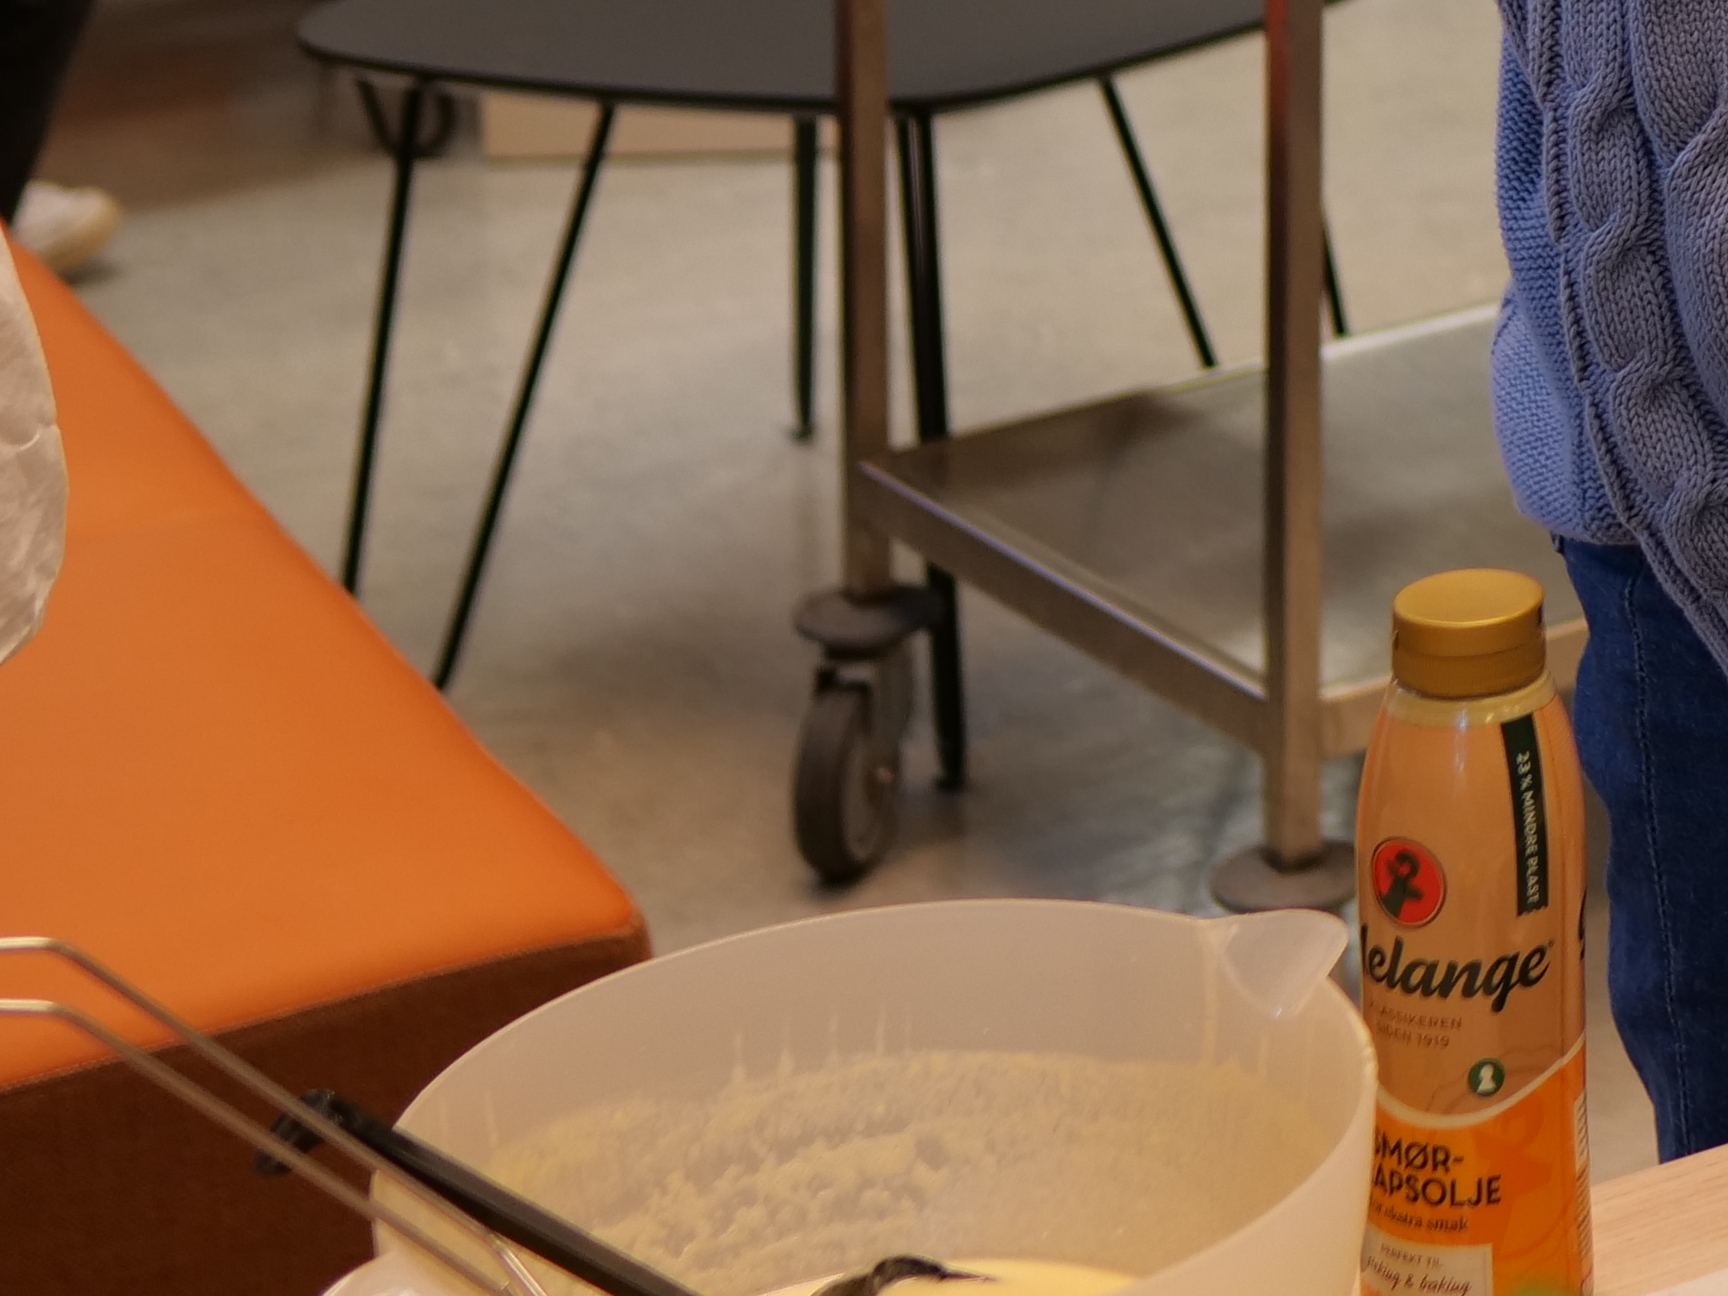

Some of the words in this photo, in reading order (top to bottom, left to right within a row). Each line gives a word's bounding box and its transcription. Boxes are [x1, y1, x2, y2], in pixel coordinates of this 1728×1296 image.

[1515, 750, 1531, 775] 23
[1519, 774, 1533, 792] %
[1520, 789, 1539, 856] MINDRE
[1525, 857, 1541, 904] PLAST
[1361, 922, 1551, 1014] elange
[1416, 1033, 1451, 1050] 1919
[1371, 1161, 1502, 1207] APSOLJE
[1427, 1215, 1469, 1233] smak
[1403, 1272, 1415, 1290] &
[1418, 1273, 1473, 1296] baking
